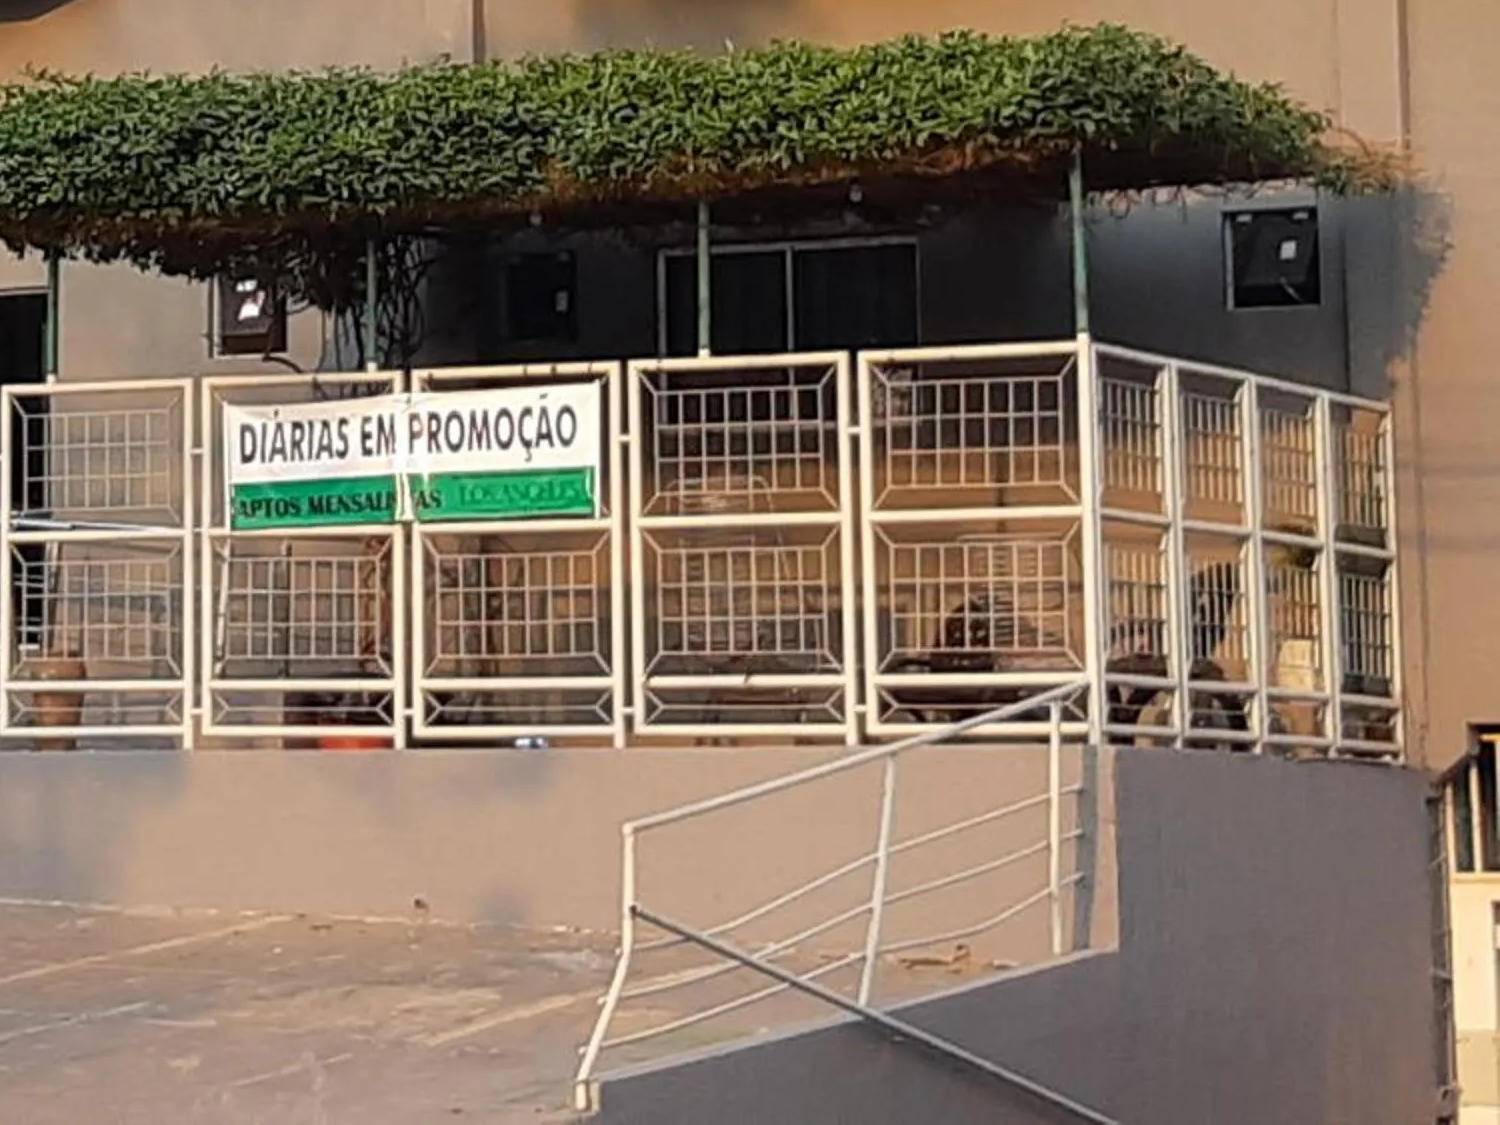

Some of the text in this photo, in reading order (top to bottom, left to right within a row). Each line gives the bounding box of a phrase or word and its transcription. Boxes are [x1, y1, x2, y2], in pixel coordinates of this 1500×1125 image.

[239, 393, 578, 465] DIÁRIAS EM PROMOÇÃO
[238, 495, 301, 519] APTOS
